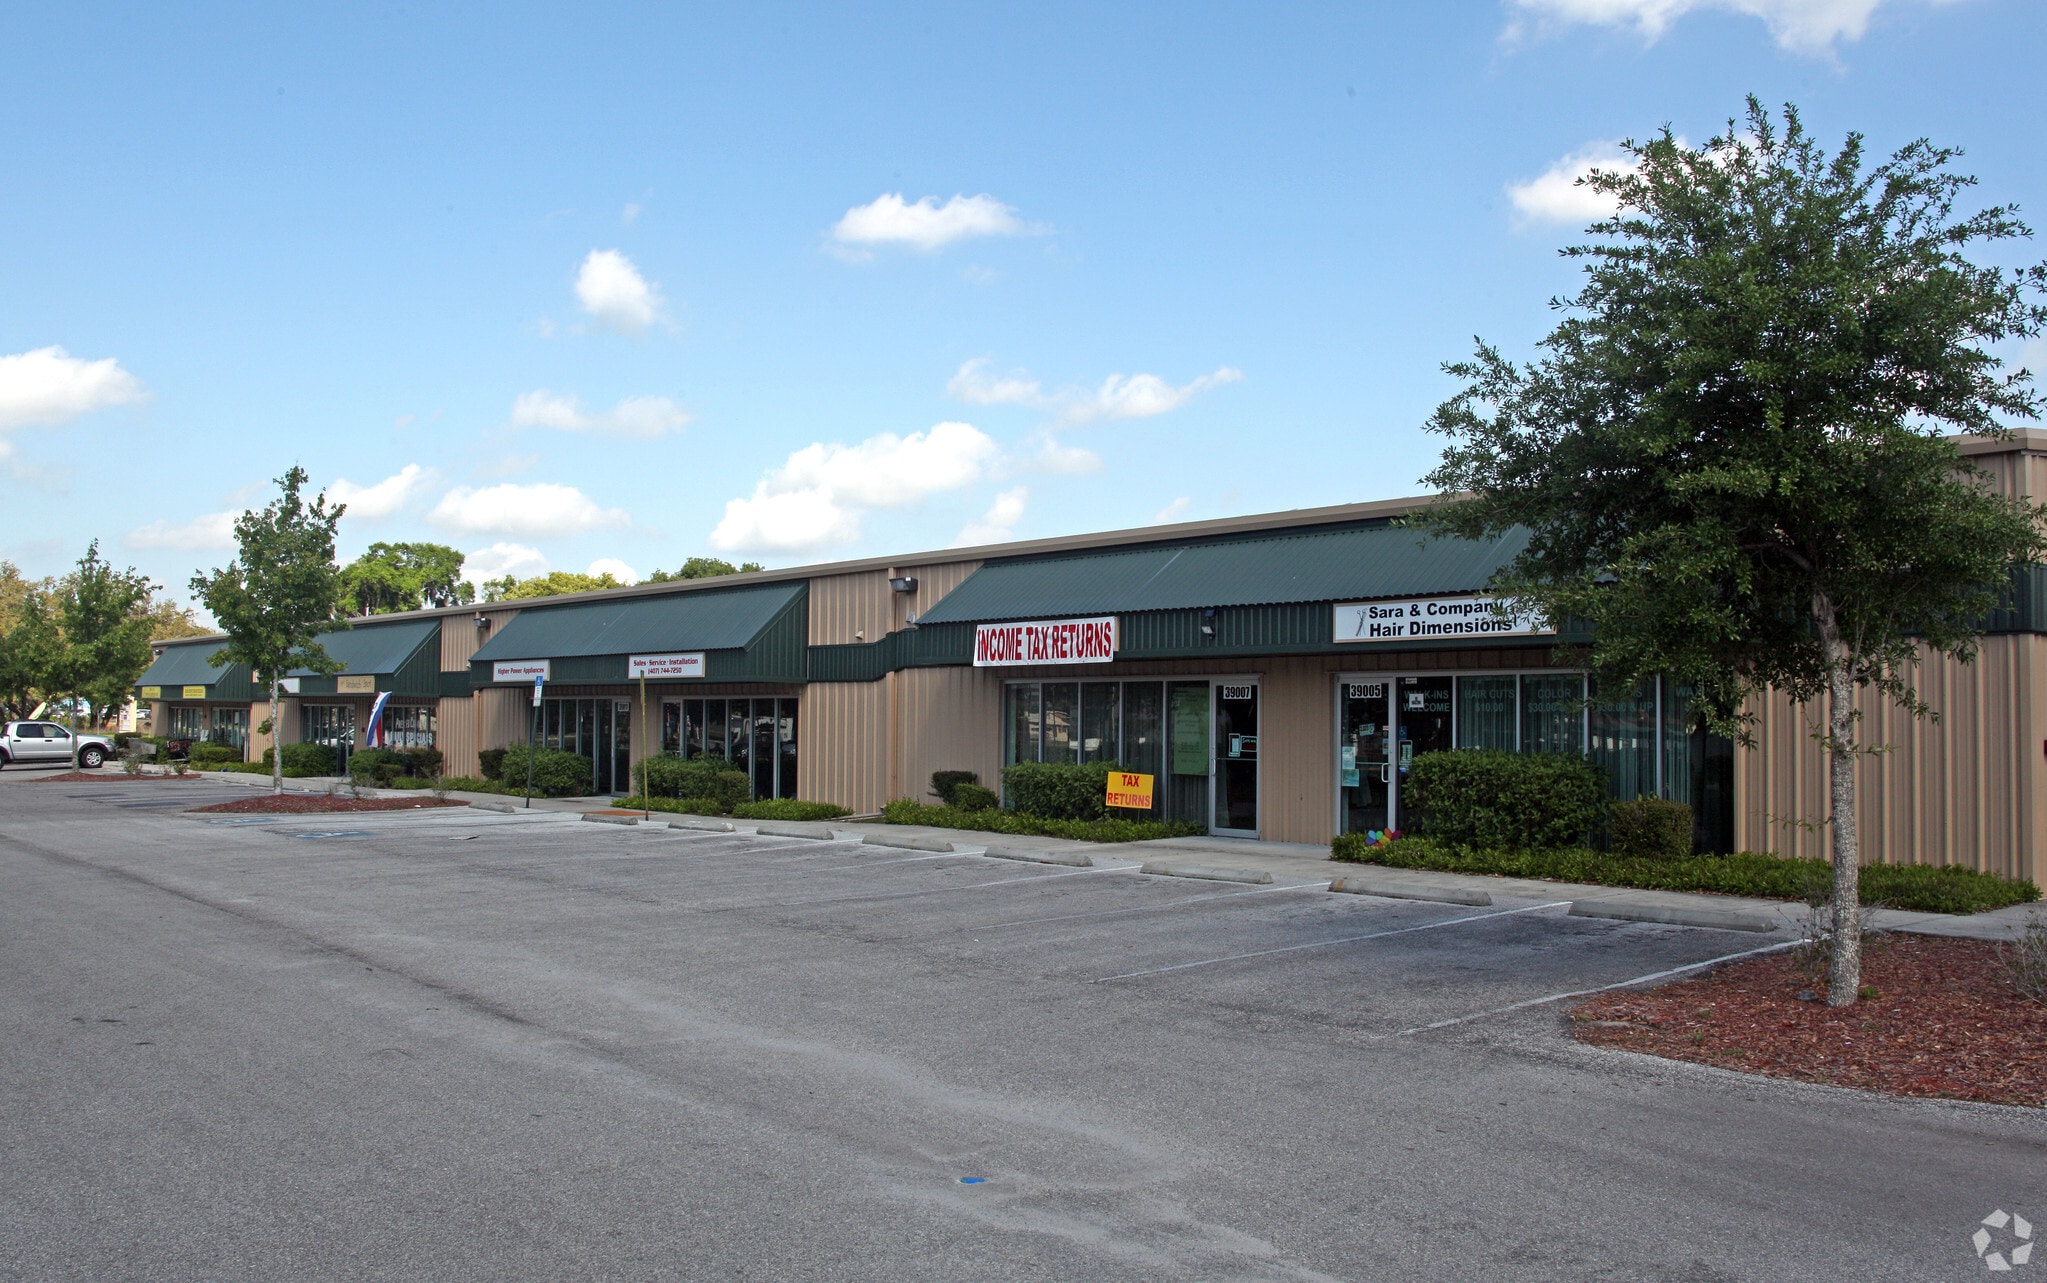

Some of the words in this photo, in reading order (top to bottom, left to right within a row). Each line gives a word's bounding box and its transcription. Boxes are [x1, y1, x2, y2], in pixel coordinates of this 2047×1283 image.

[1368, 606, 1404, 619] Sara
[1410, 604, 1421, 617] &
[1427, 601, 1504, 619] Company
[1370, 623, 1405, 637] Hair
[1409, 619, 1513, 635] Dimensions
[977, 628, 1023, 665] INCOME
[1026, 626, 1050, 661] TAX
[1052, 621, 1112, 659] RETURNS
[649, 659, 667, 667] Service
[669, 657, 698, 665] Installation
[497, 668, 510, 676] Higher
[523, 667, 545, 675] Appliances
[1225, 685, 1251, 699] 39007
[1351, 684, 1381, 697] 39005
[1404, 690, 1449, 699] WK-INS
[1464, 689, 1486, 698] HAIR
[1489, 689, 1515, 698] CUTS
[1537, 689, 1571, 698] COLOR
[1474, 703, 1504, 712] $10.00
[1121, 774, 1140, 787] TAX
[1107, 791, 1151, 807] RETURNS
